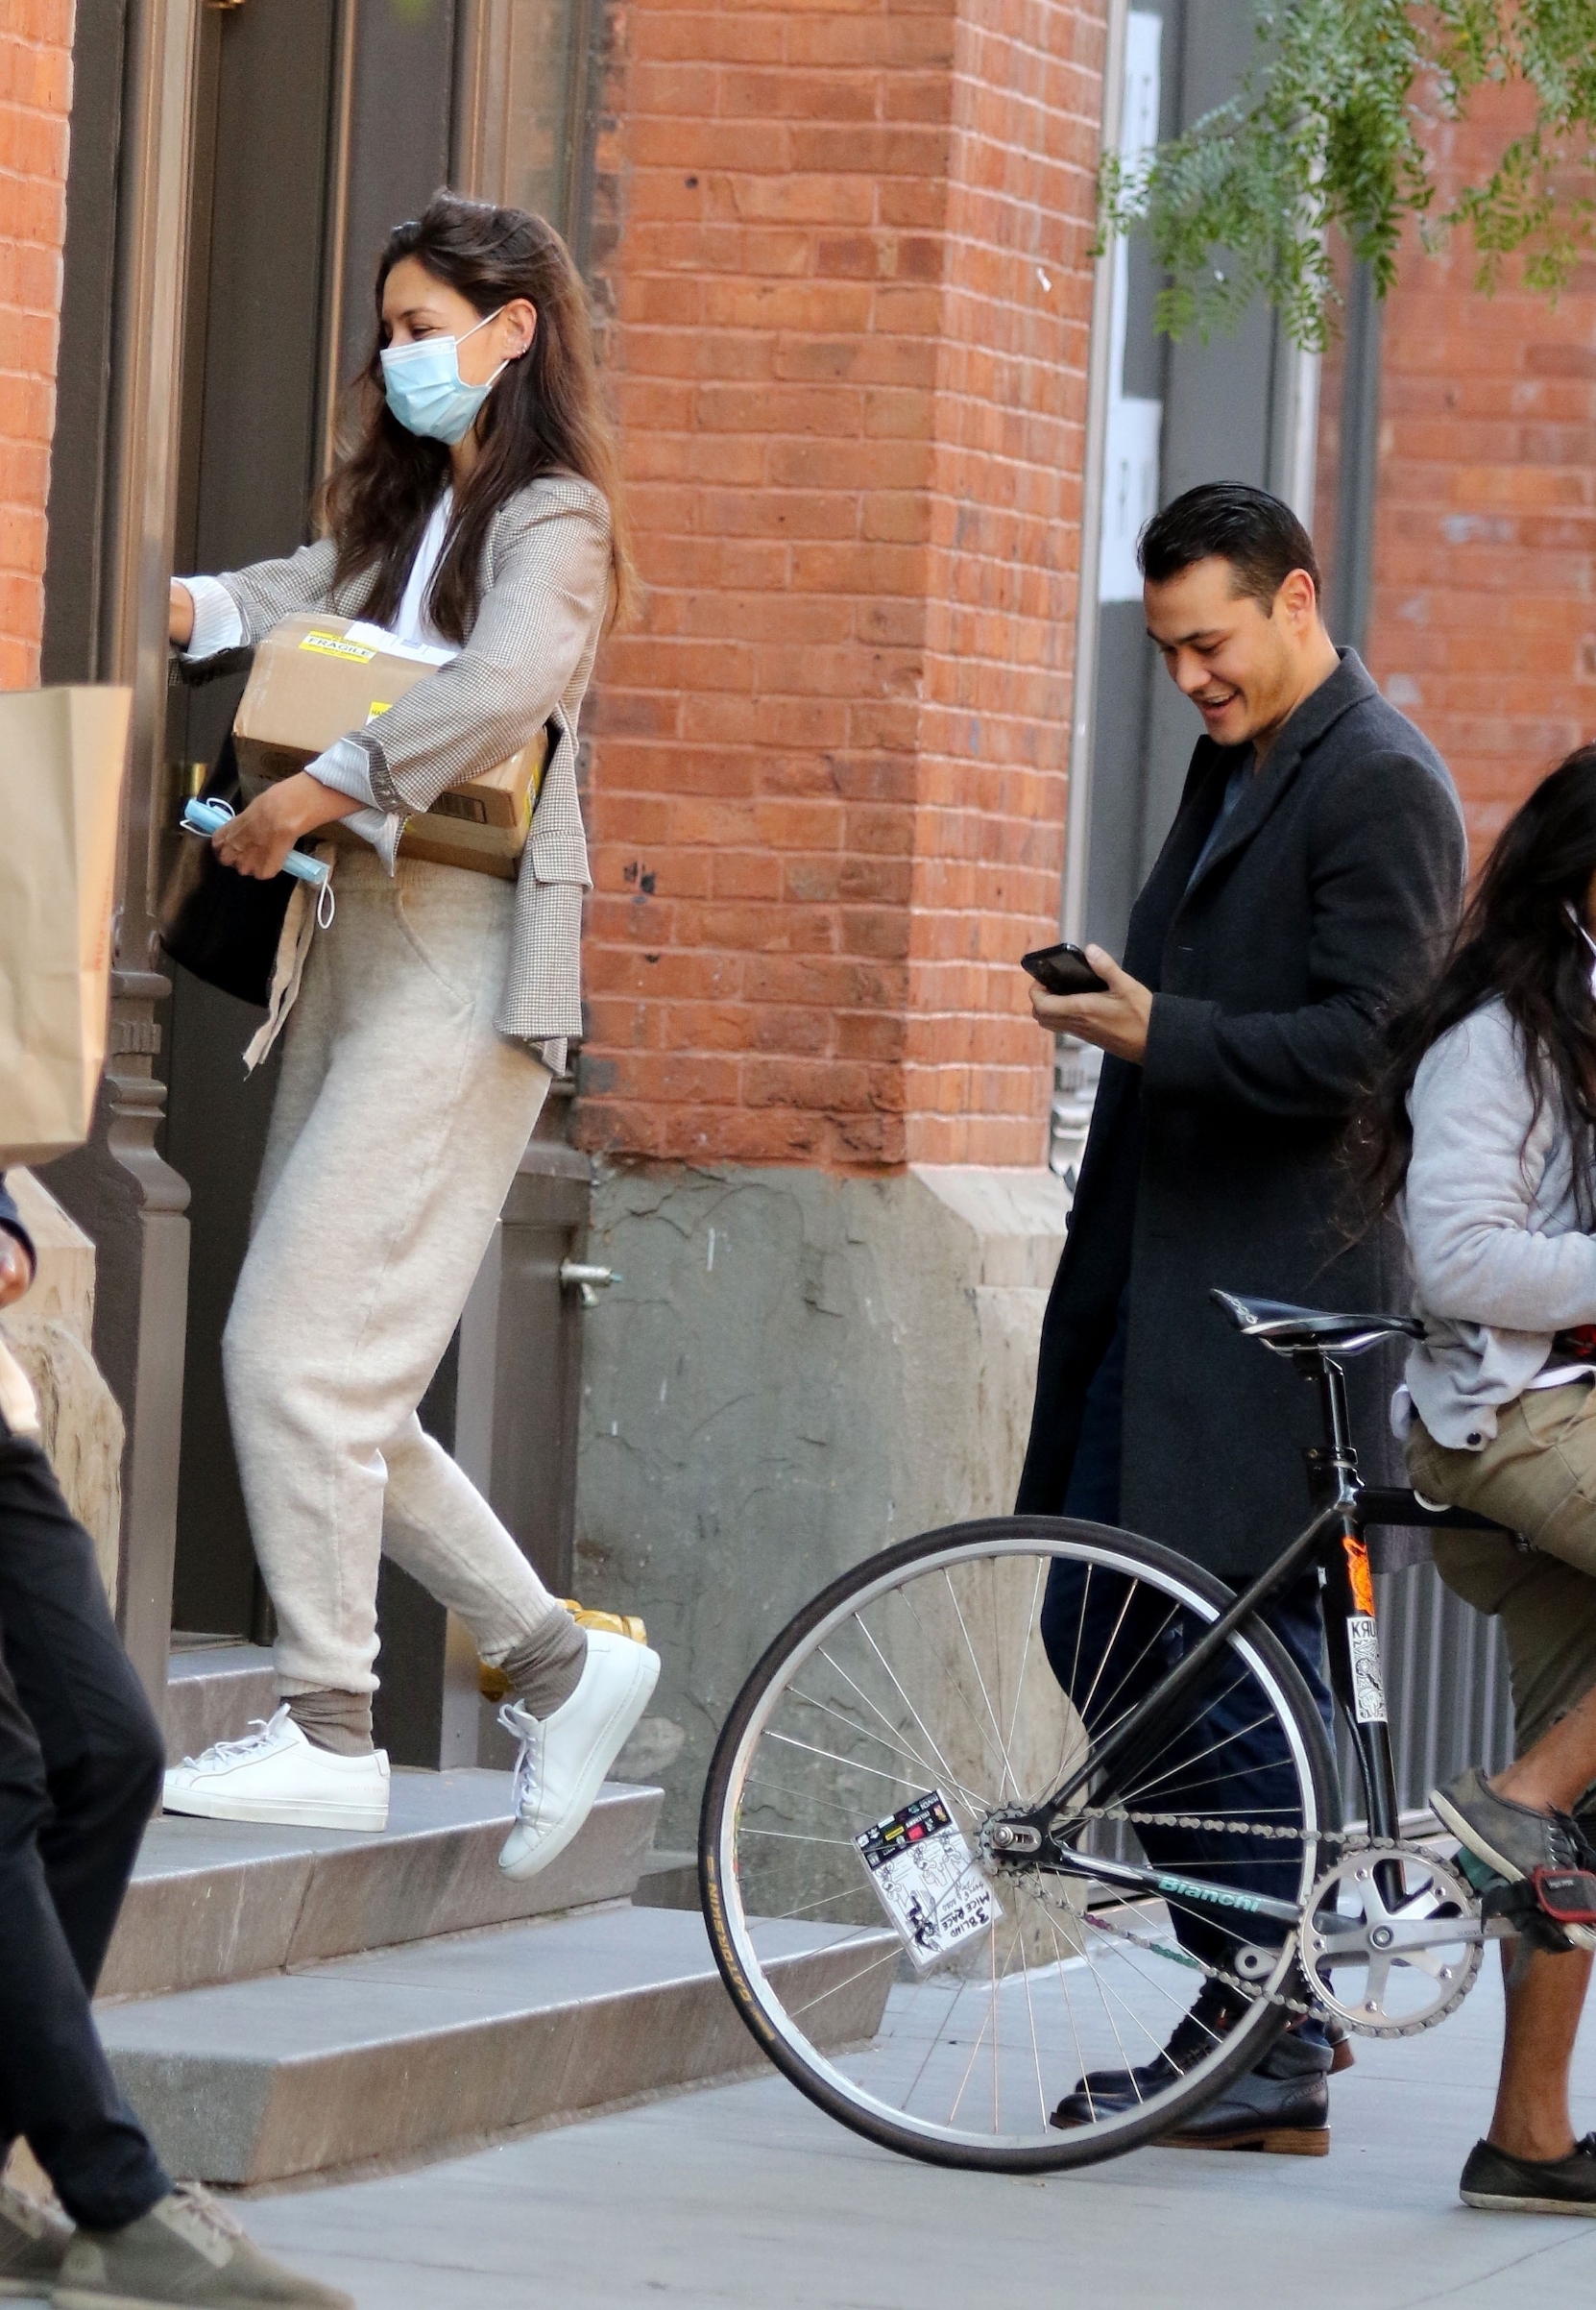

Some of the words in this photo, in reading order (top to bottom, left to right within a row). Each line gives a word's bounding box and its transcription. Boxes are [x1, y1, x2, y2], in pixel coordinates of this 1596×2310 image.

[308, 638, 371, 657] FRAGILE
[965, 1890, 990, 1912] MICE
[1158, 1876, 1261, 1912] Bianchi
[941, 1907, 965, 1931] RACE
[950, 1916, 979, 1937] BLIND
[976, 1907, 989, 1924] 3
[708, 1882, 753, 2002] GATORSKIN
